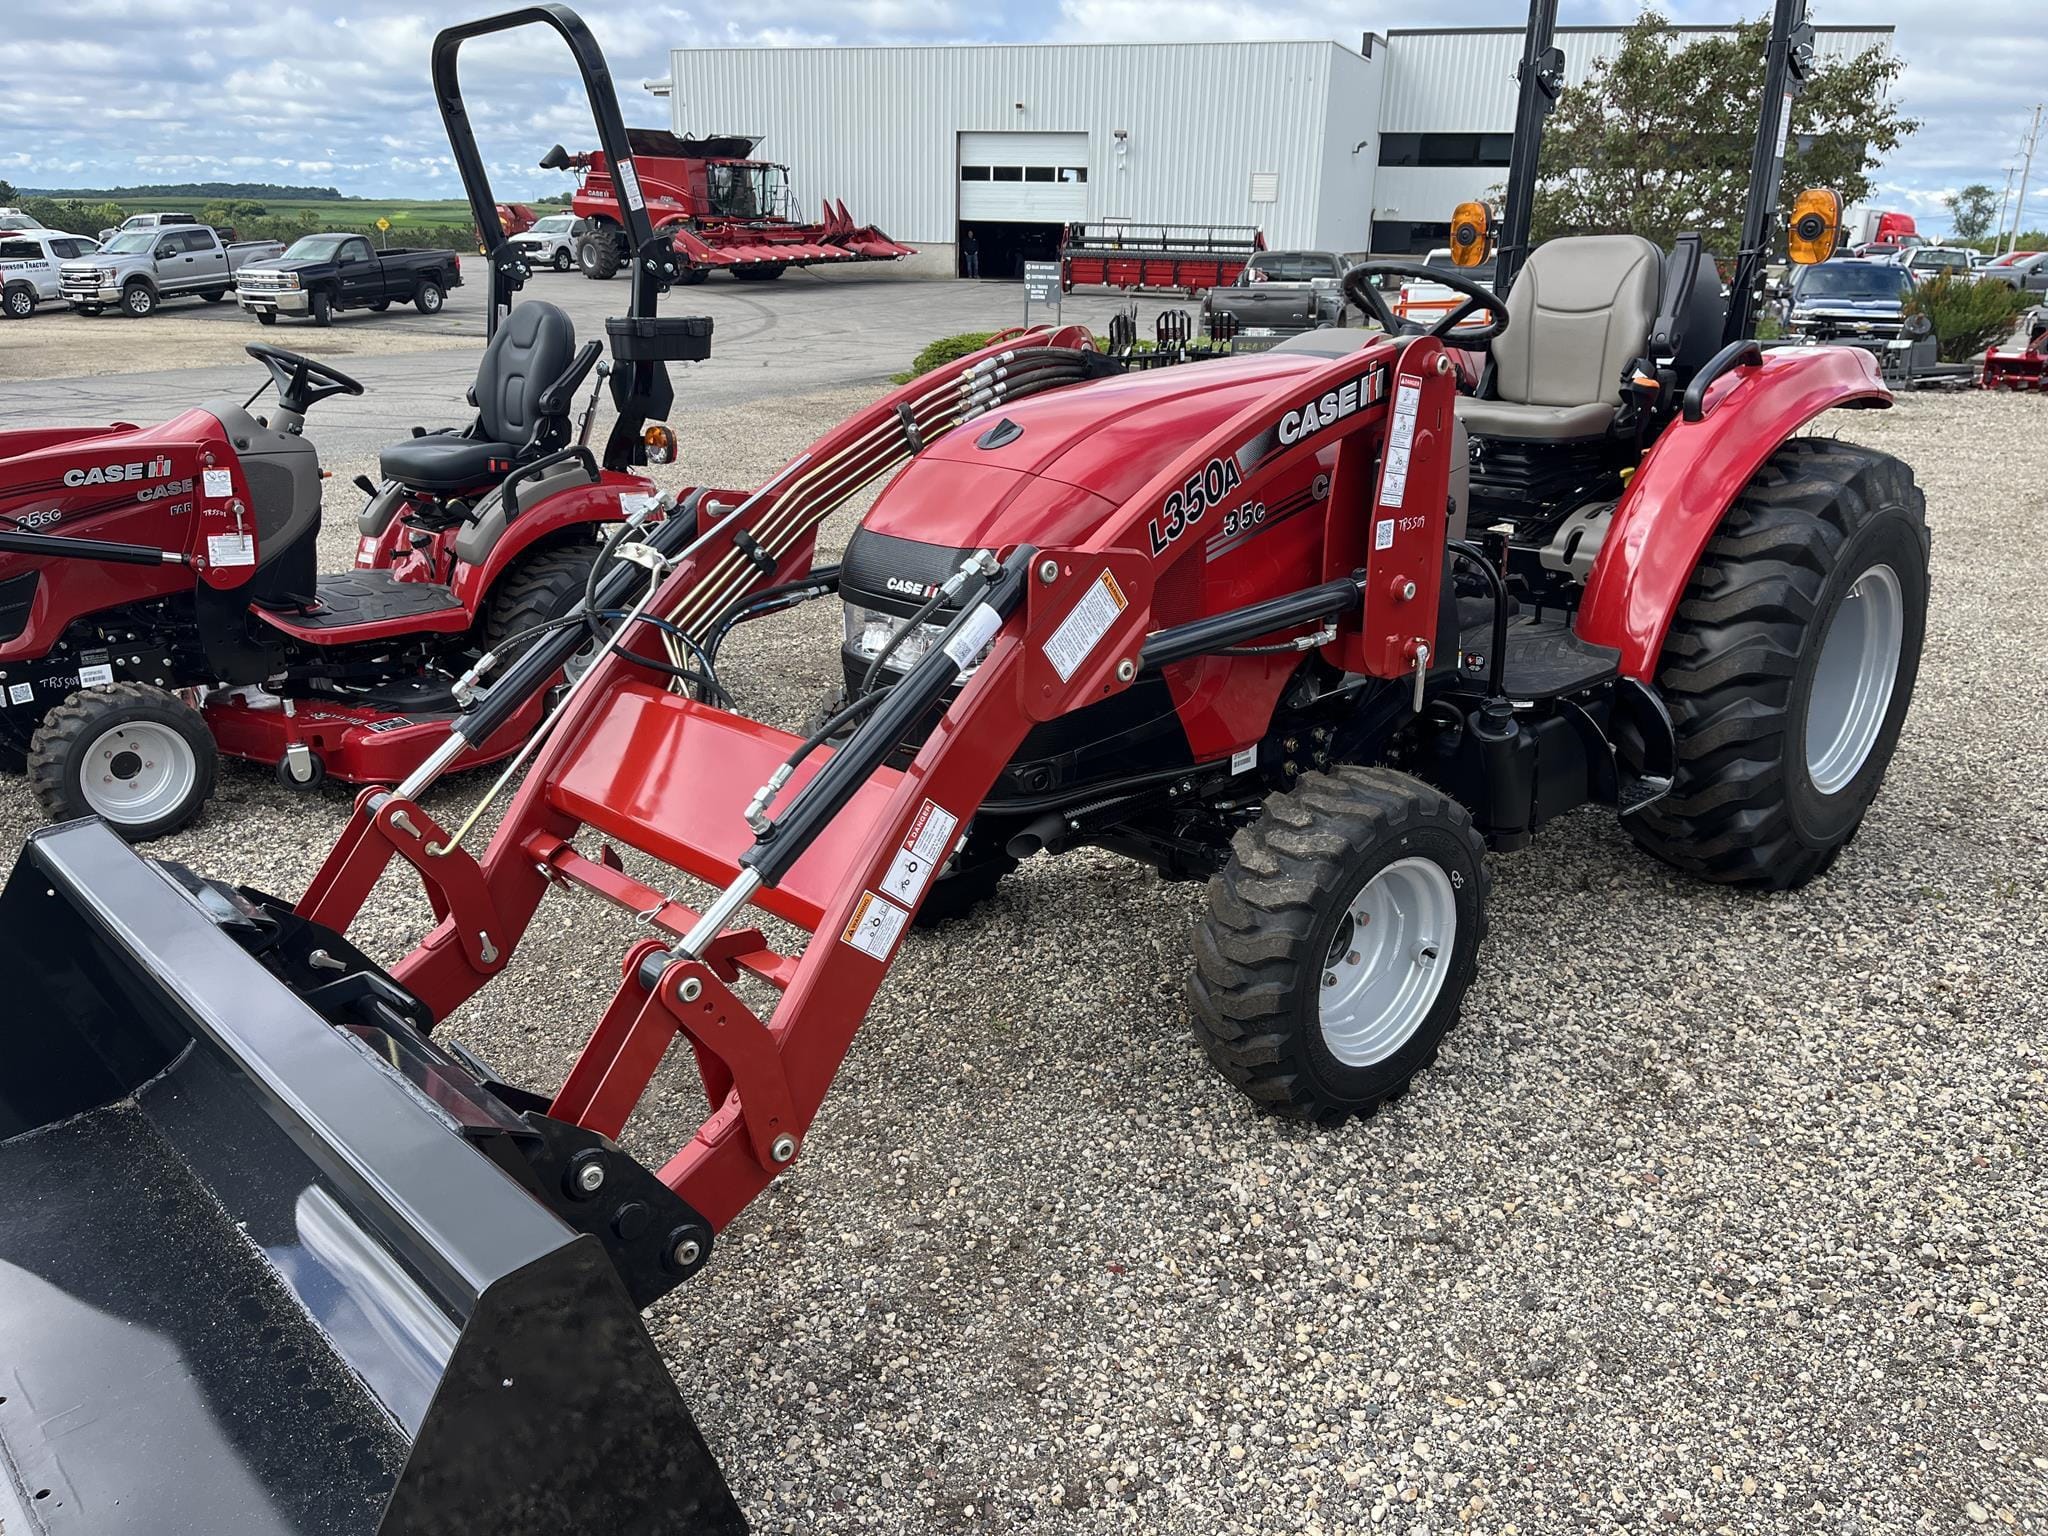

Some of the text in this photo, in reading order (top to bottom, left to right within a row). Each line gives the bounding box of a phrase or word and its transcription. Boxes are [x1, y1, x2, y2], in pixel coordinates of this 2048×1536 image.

[1278, 381, 1358, 445] CASE
[63, 462, 144, 487] CASE
[137, 478, 193, 502] CASE
[1148, 456, 1241, 559] L350A
[887, 577, 924, 596] CASE
[912, 805, 932, 839] DANGER
[853, 898, 870, 930] WARNING
